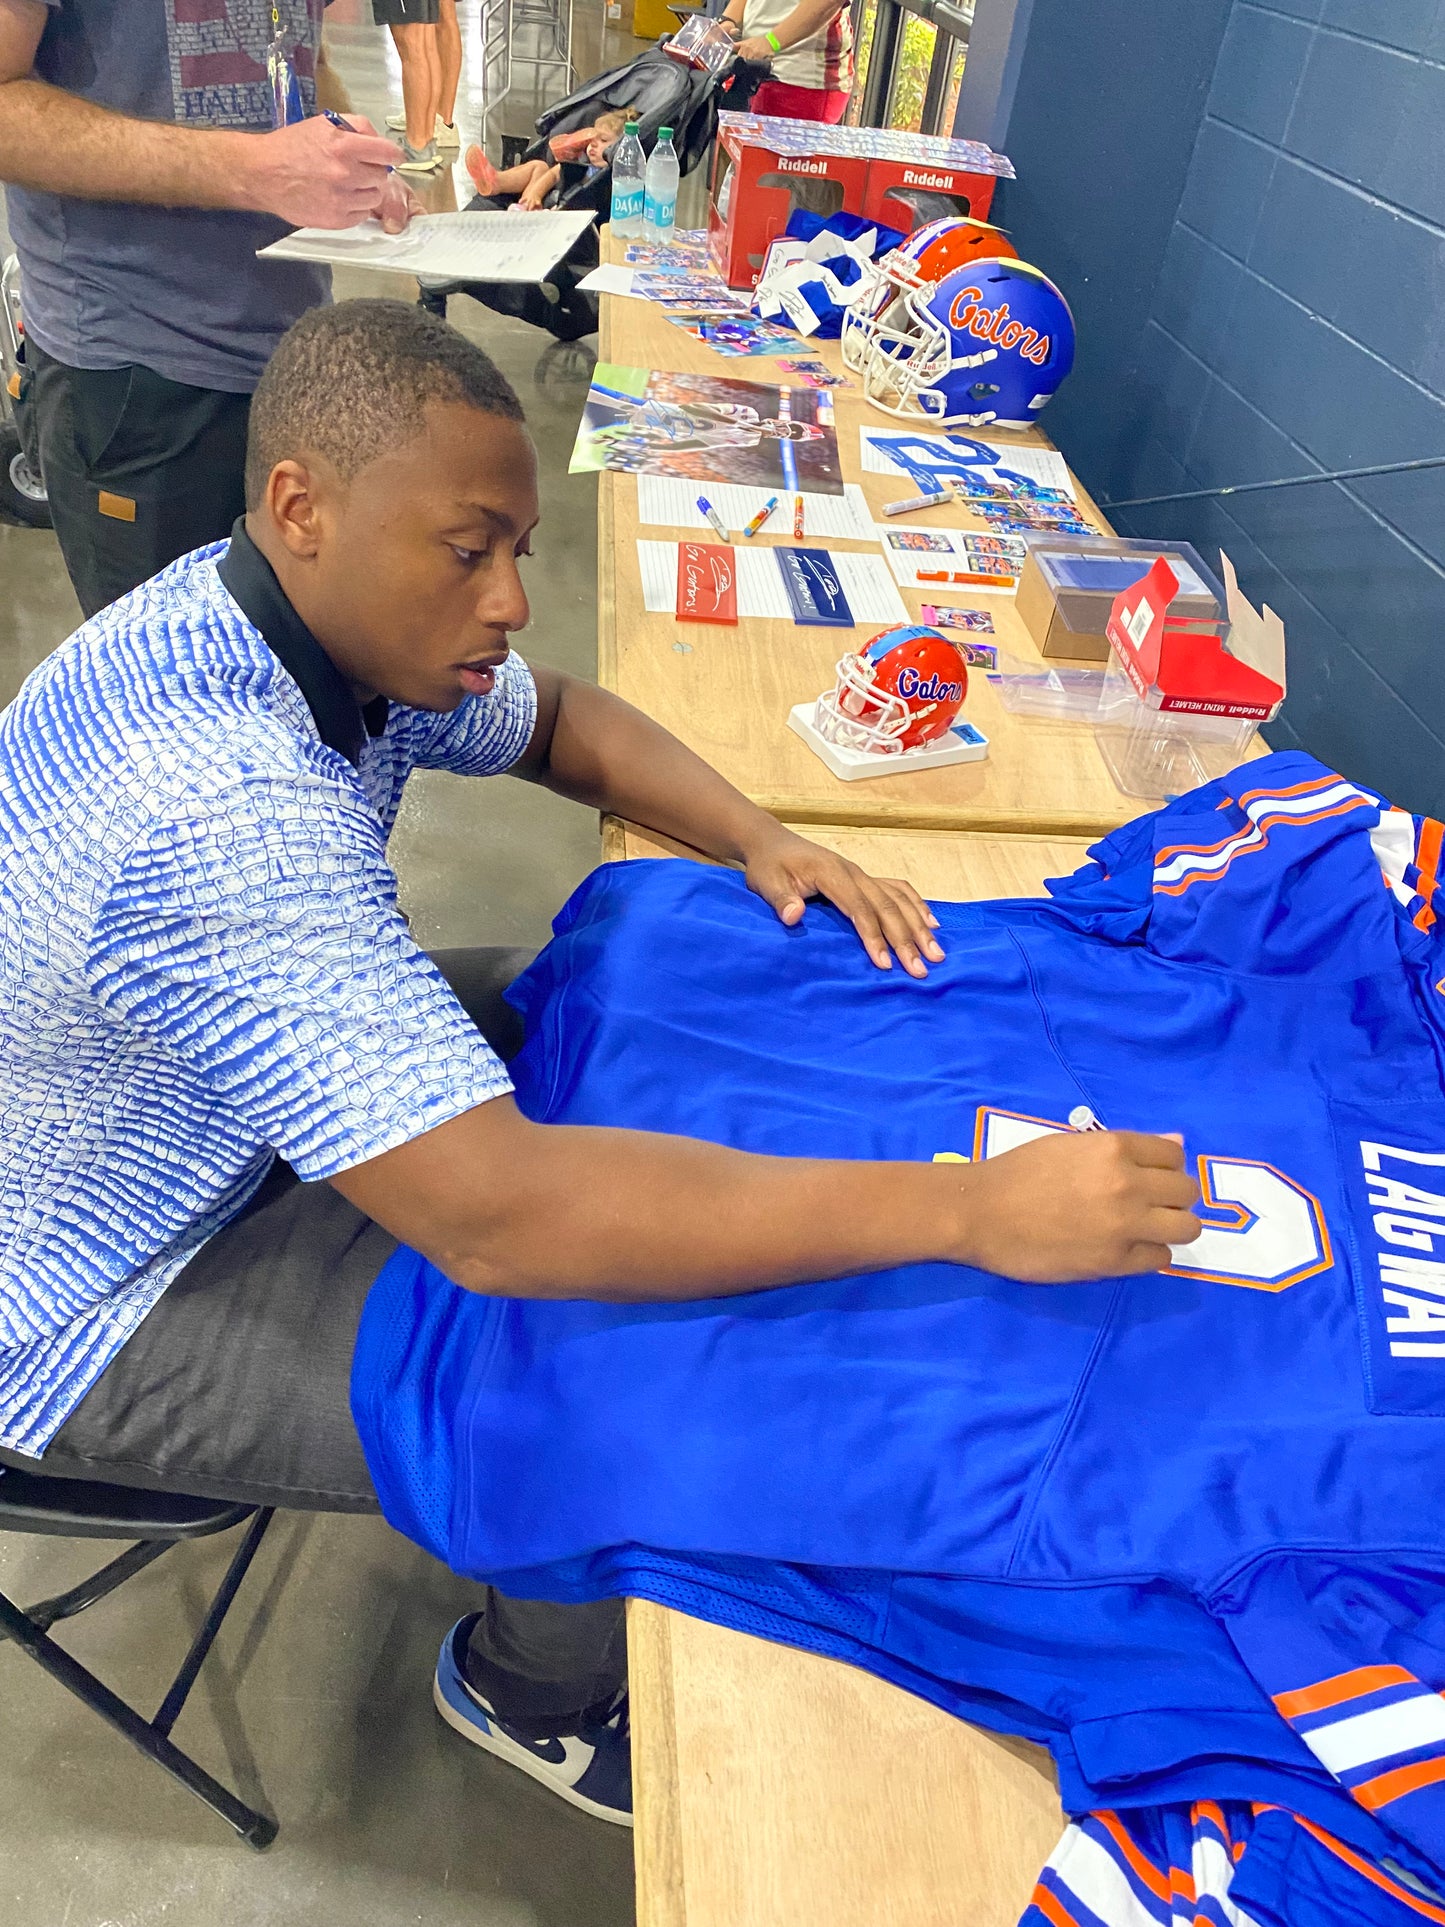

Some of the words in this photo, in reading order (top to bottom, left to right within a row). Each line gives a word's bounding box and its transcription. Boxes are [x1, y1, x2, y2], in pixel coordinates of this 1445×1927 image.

[778, 157, 828, 175] Riddell
[903, 170, 954, 189] Riddell
[949, 285, 1050, 366] Gators
[1168, 700, 1202, 710] HELMET
[1202, 703, 1226, 712] MINI
